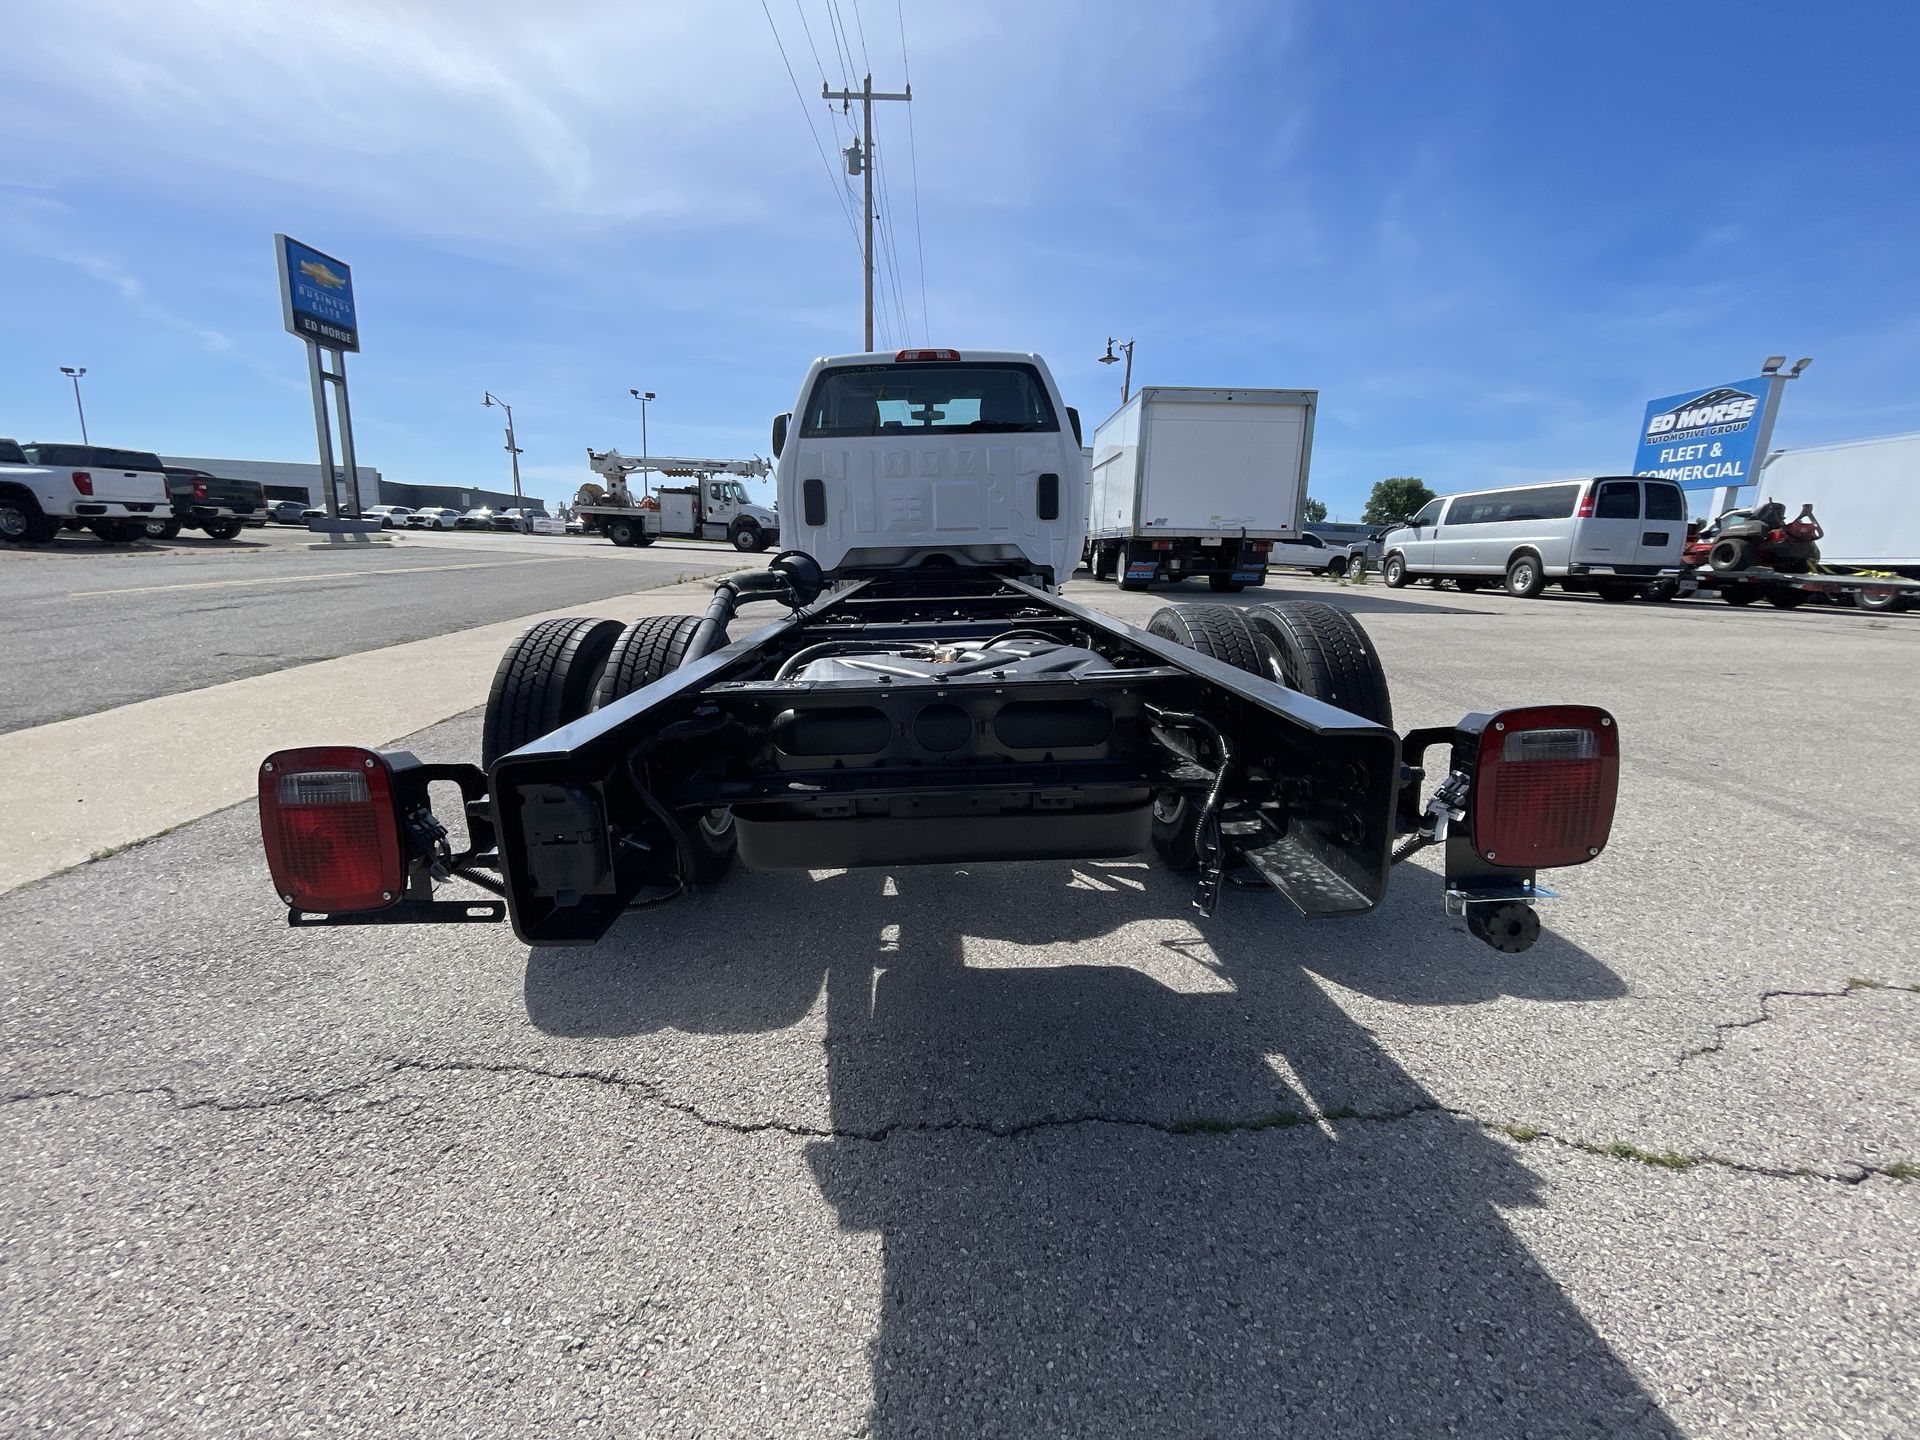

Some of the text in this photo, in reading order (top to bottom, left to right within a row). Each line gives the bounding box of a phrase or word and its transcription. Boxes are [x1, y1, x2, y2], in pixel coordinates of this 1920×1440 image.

[299, 286, 350, 312] BUSINESS
[312, 301, 341, 319] ELITE
[305, 319, 352, 343] ED MORSE
[1648, 399, 1757, 434] ED MORSE
[1646, 422, 1748, 445] AUTOMOTIVE GROUP
[1660, 442, 1723, 464] FLEET &
